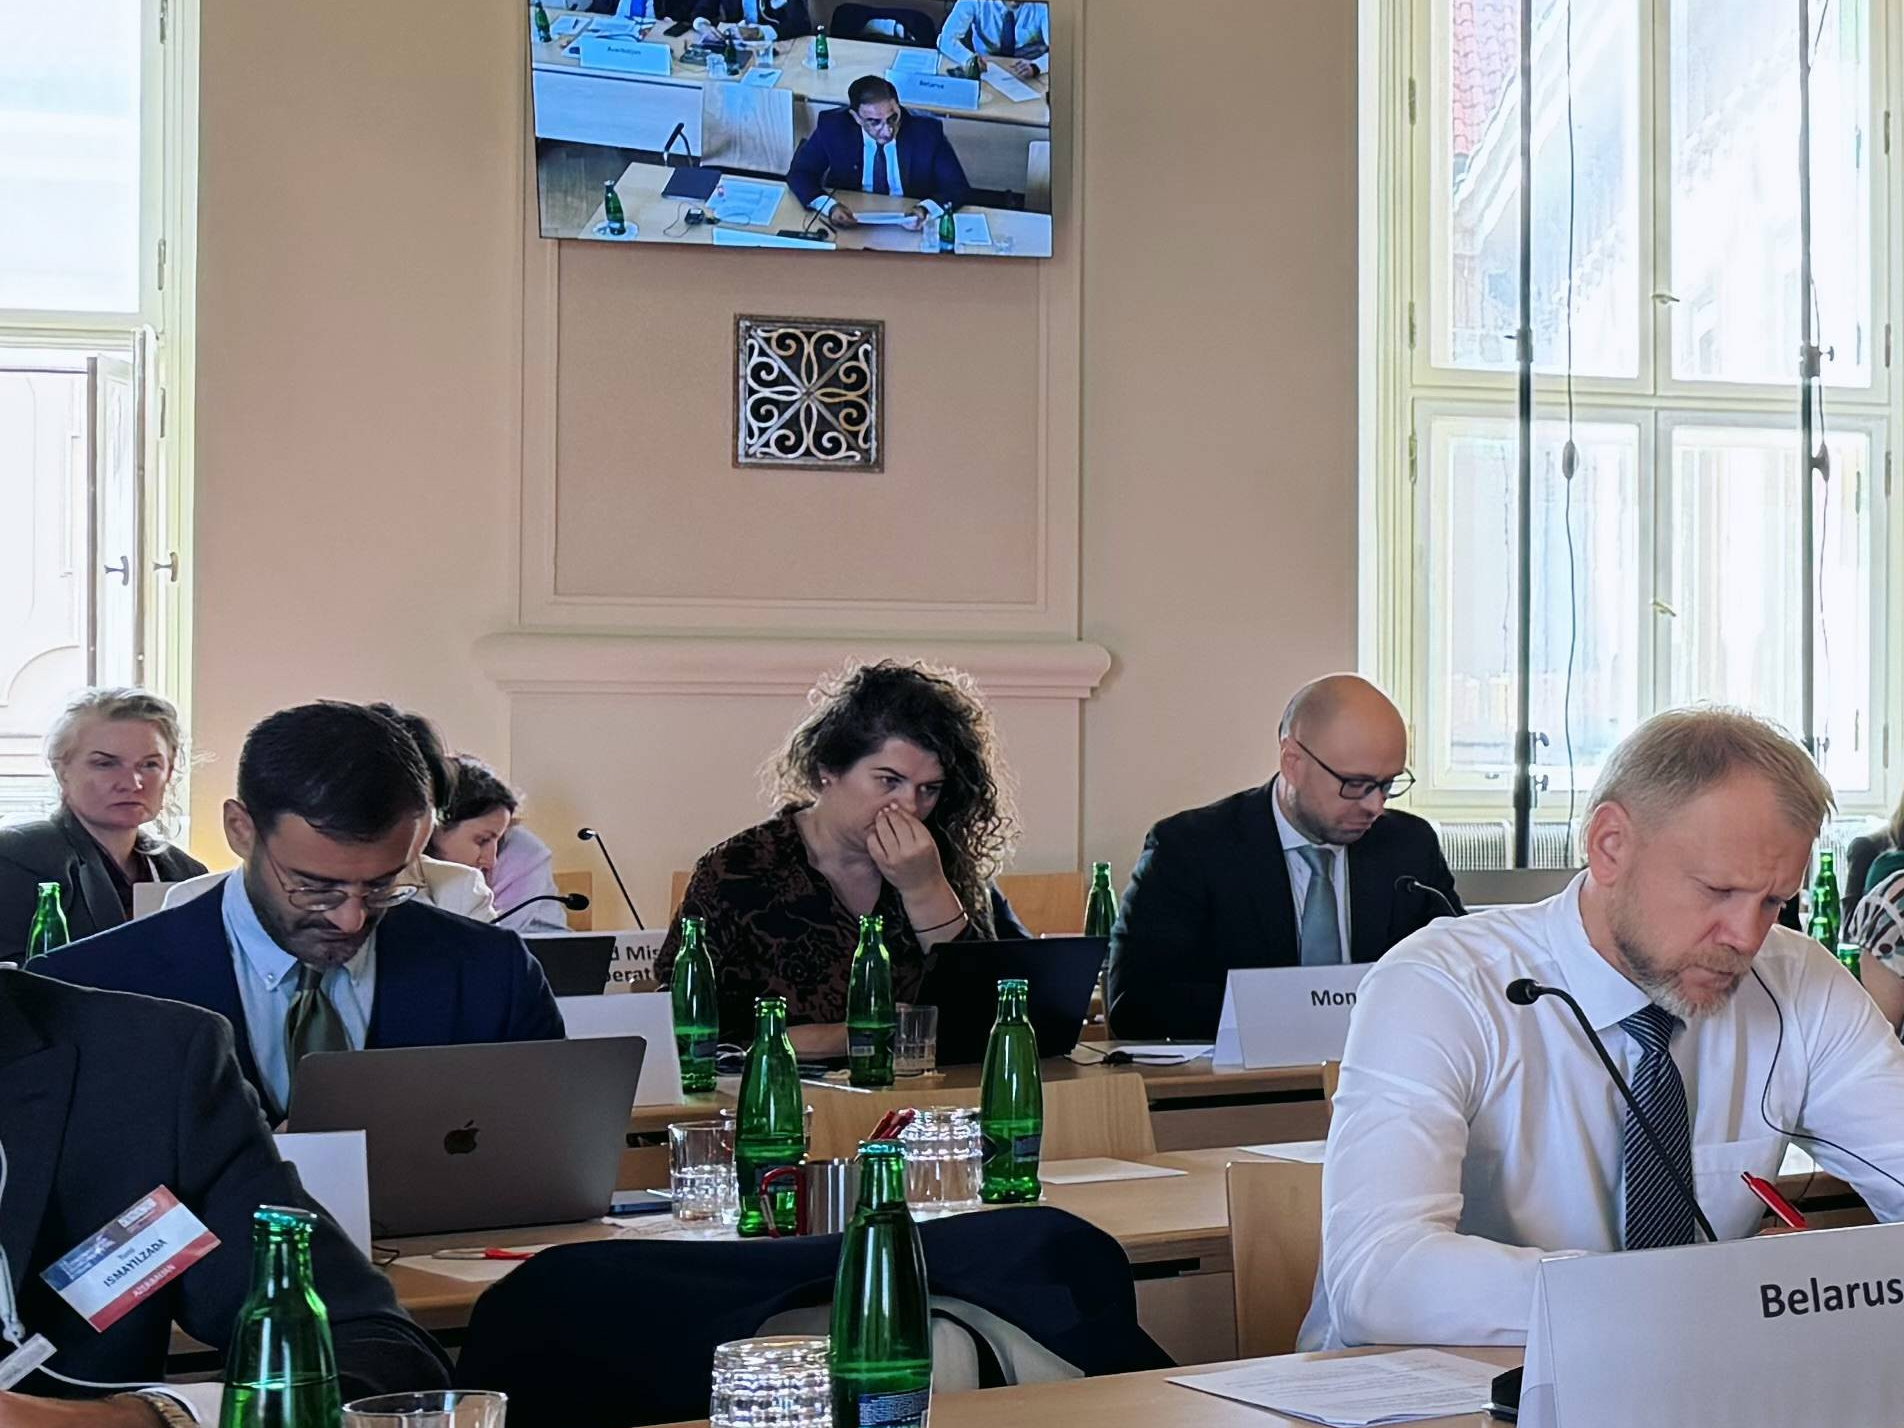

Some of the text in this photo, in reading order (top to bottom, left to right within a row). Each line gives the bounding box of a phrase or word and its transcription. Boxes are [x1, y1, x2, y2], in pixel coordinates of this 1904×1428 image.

[626, 944, 659, 961] Mis
[1310, 989, 1357, 1006] Mon
[1759, 1276, 1904, 1319] Belarus
